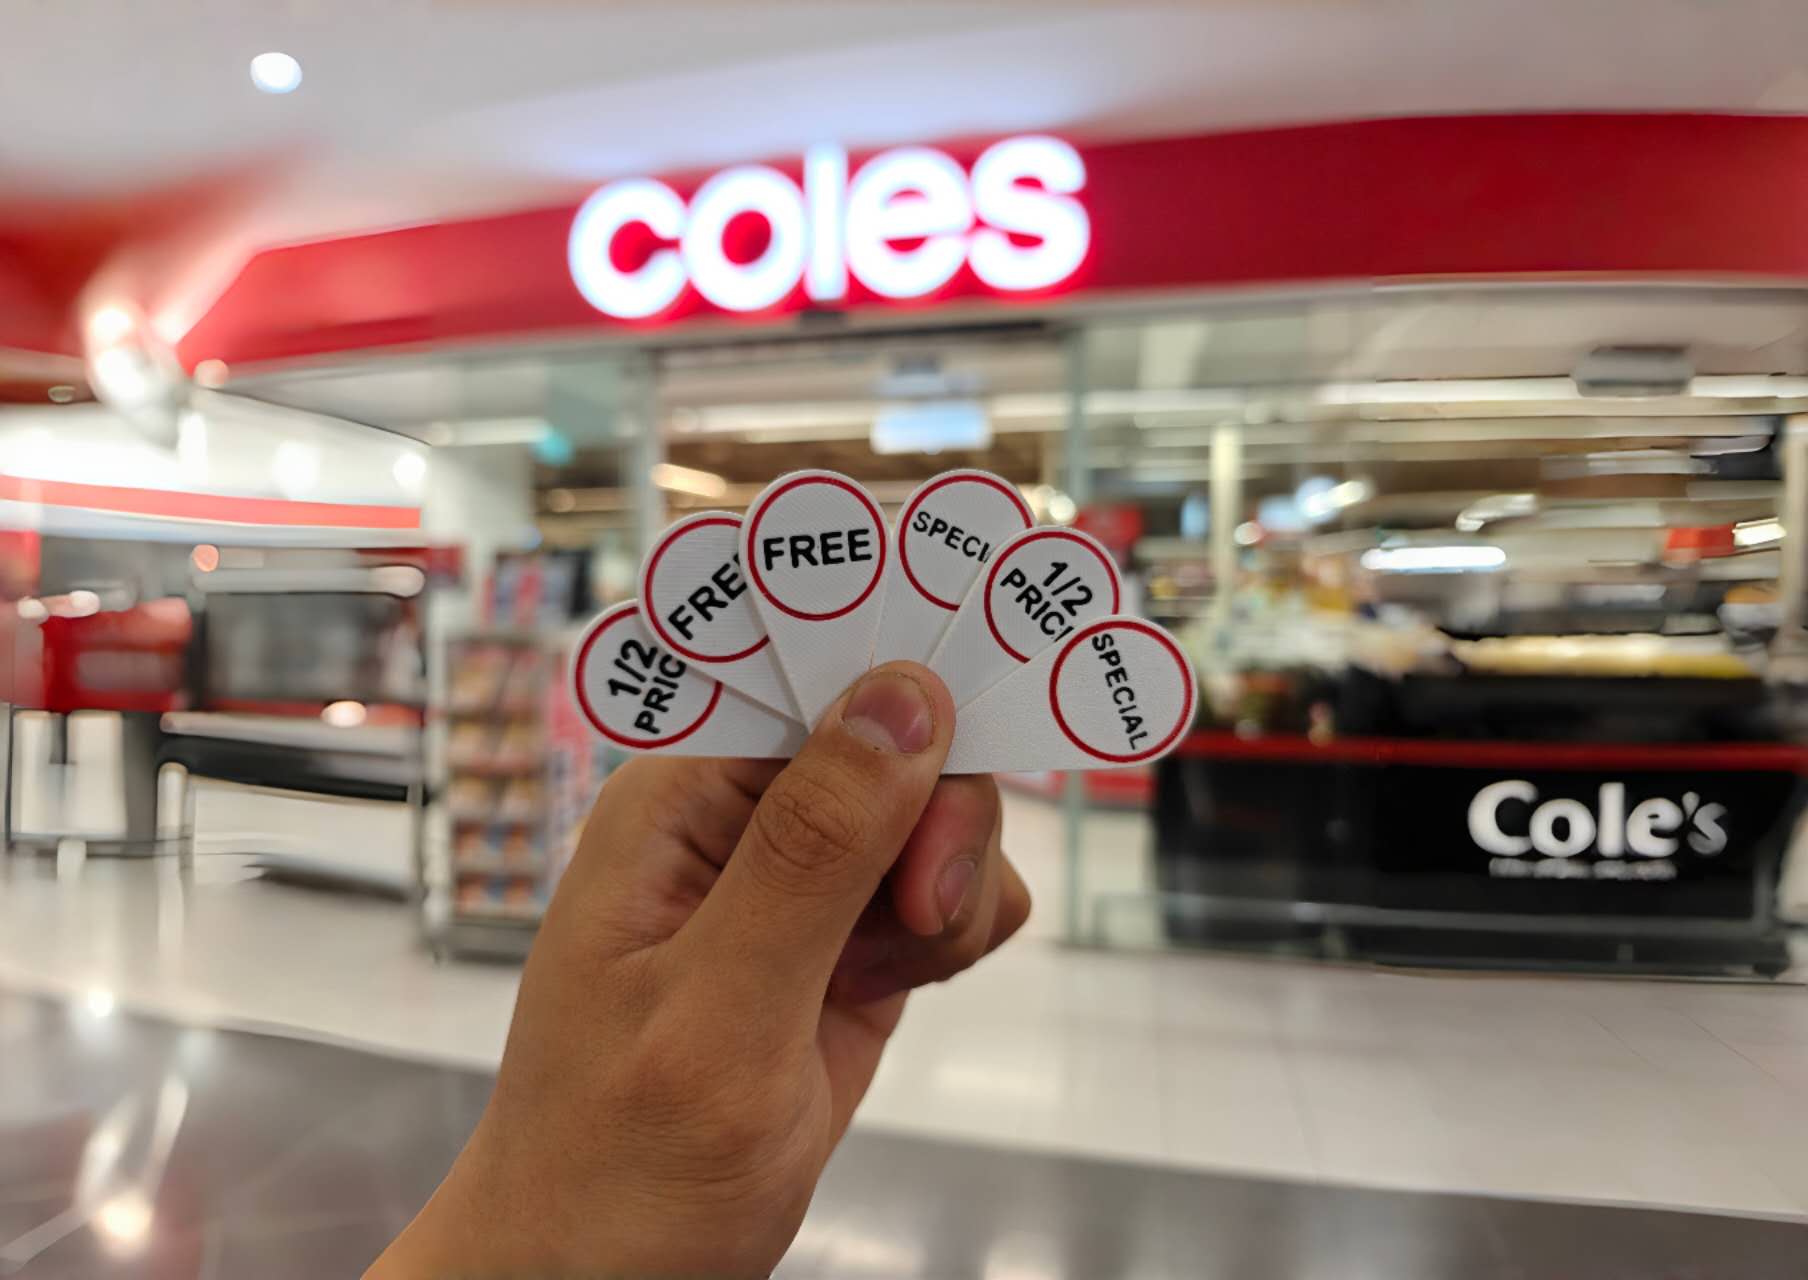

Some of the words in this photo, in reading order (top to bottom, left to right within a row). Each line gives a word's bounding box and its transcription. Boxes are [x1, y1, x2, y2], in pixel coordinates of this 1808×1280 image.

[567, 136, 1091, 319] coles
[763, 528, 873, 571] FREE
[912, 510, 990, 564] SPECI
[667, 552, 748, 641] FRE
[1000, 567, 1074, 643] PRIC
[1042, 562, 1093, 617] 1/2
[608, 639, 658, 697] 1/2
[634, 654, 688, 735] PRIC
[1092, 633, 1148, 751] SPECIAL
[1467, 779, 1729, 858] Cole's
